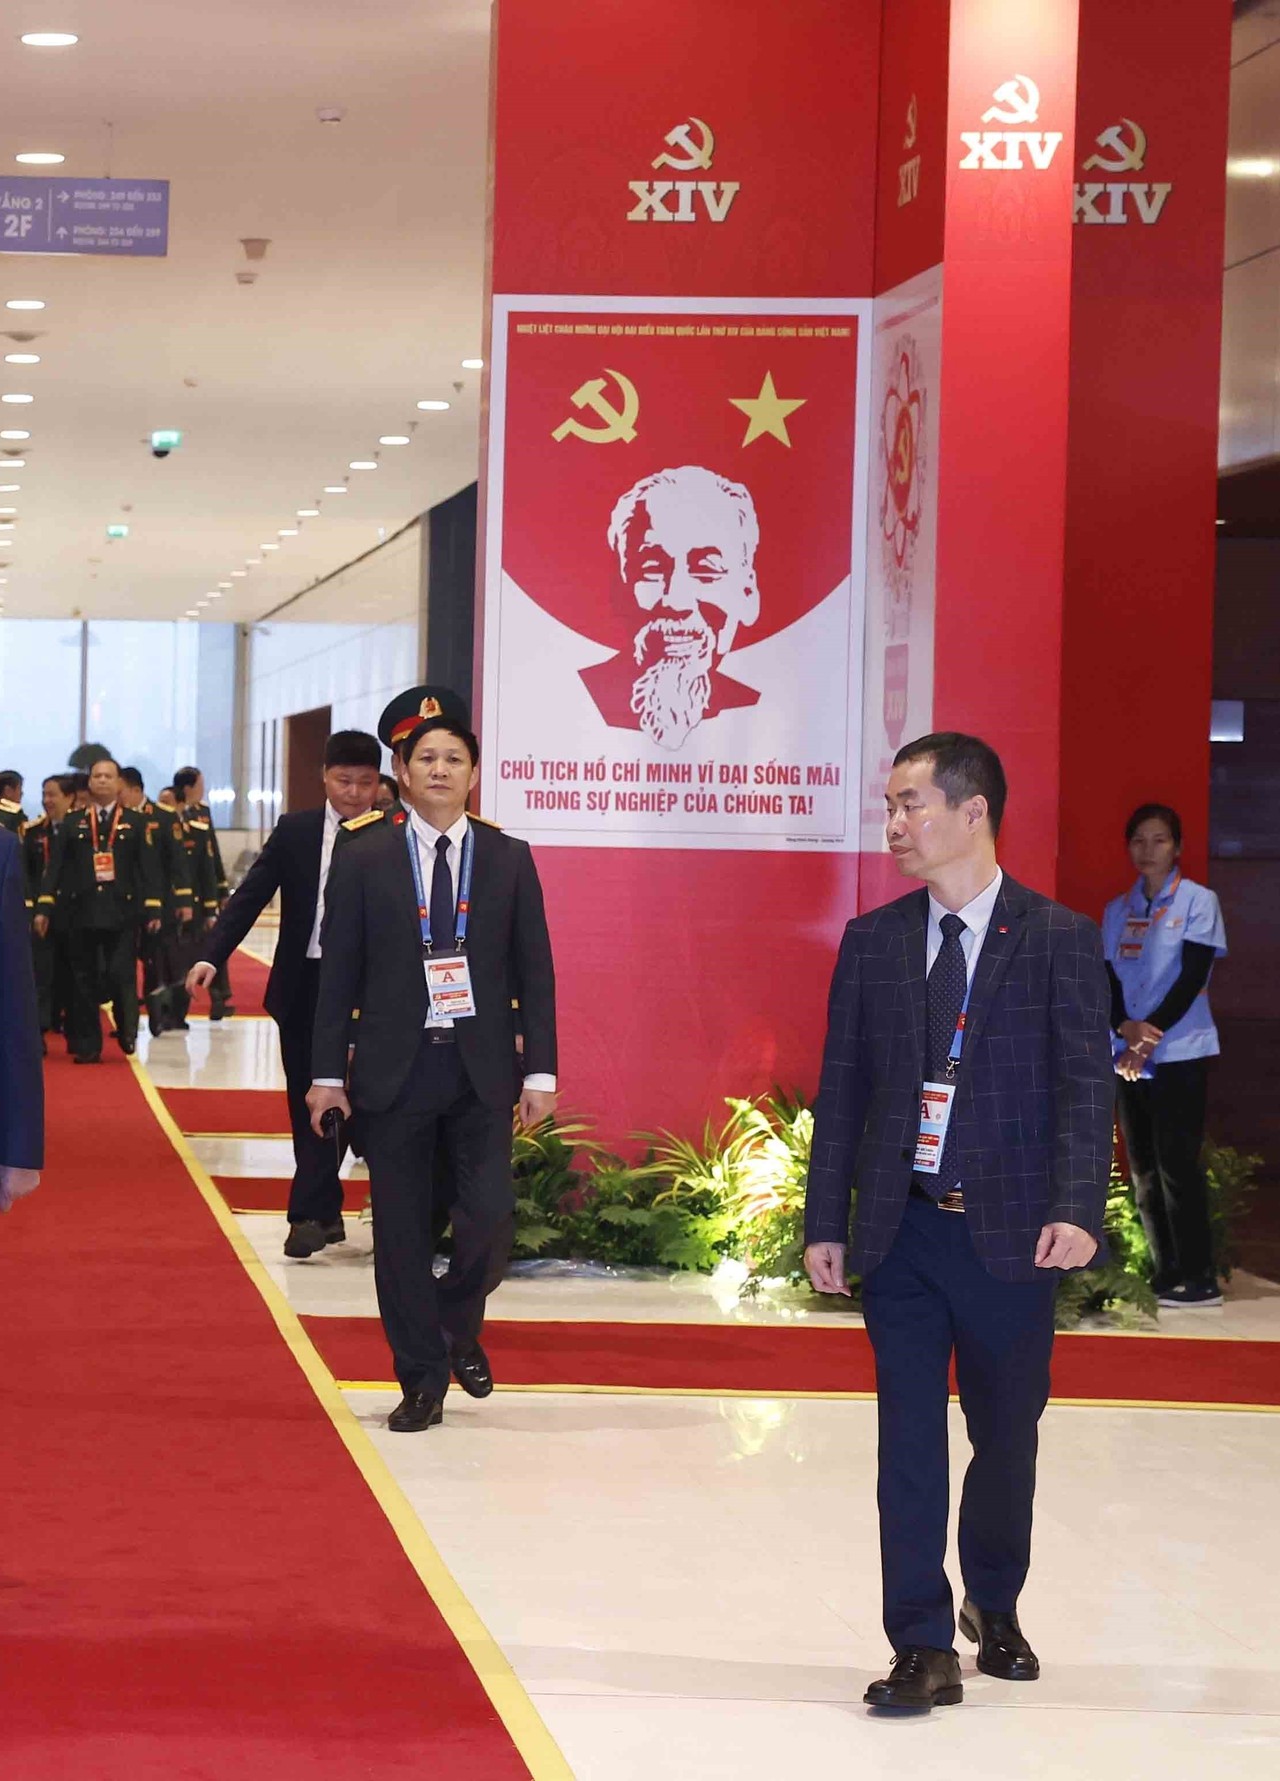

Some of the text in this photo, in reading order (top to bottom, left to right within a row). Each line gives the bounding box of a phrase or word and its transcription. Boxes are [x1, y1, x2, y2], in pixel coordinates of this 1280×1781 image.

[959, 132, 1063, 170] XIV
[35, 197, 43, 210] 2
[627, 180, 740, 222] XIV
[1073, 183, 1172, 225] XIV
[4, 214, 32, 237] 2F
[500, 754, 840, 789] CHỦ TỊCH HỒ CHÍ MINH VĨ ĐẠI SỐNG MÃI
[524, 787, 814, 817] TRONG SỰ NGHIỆP CỦA CHÚNG TA!
[442, 971, 455, 983] A
[920, 1102, 931, 1119] A
